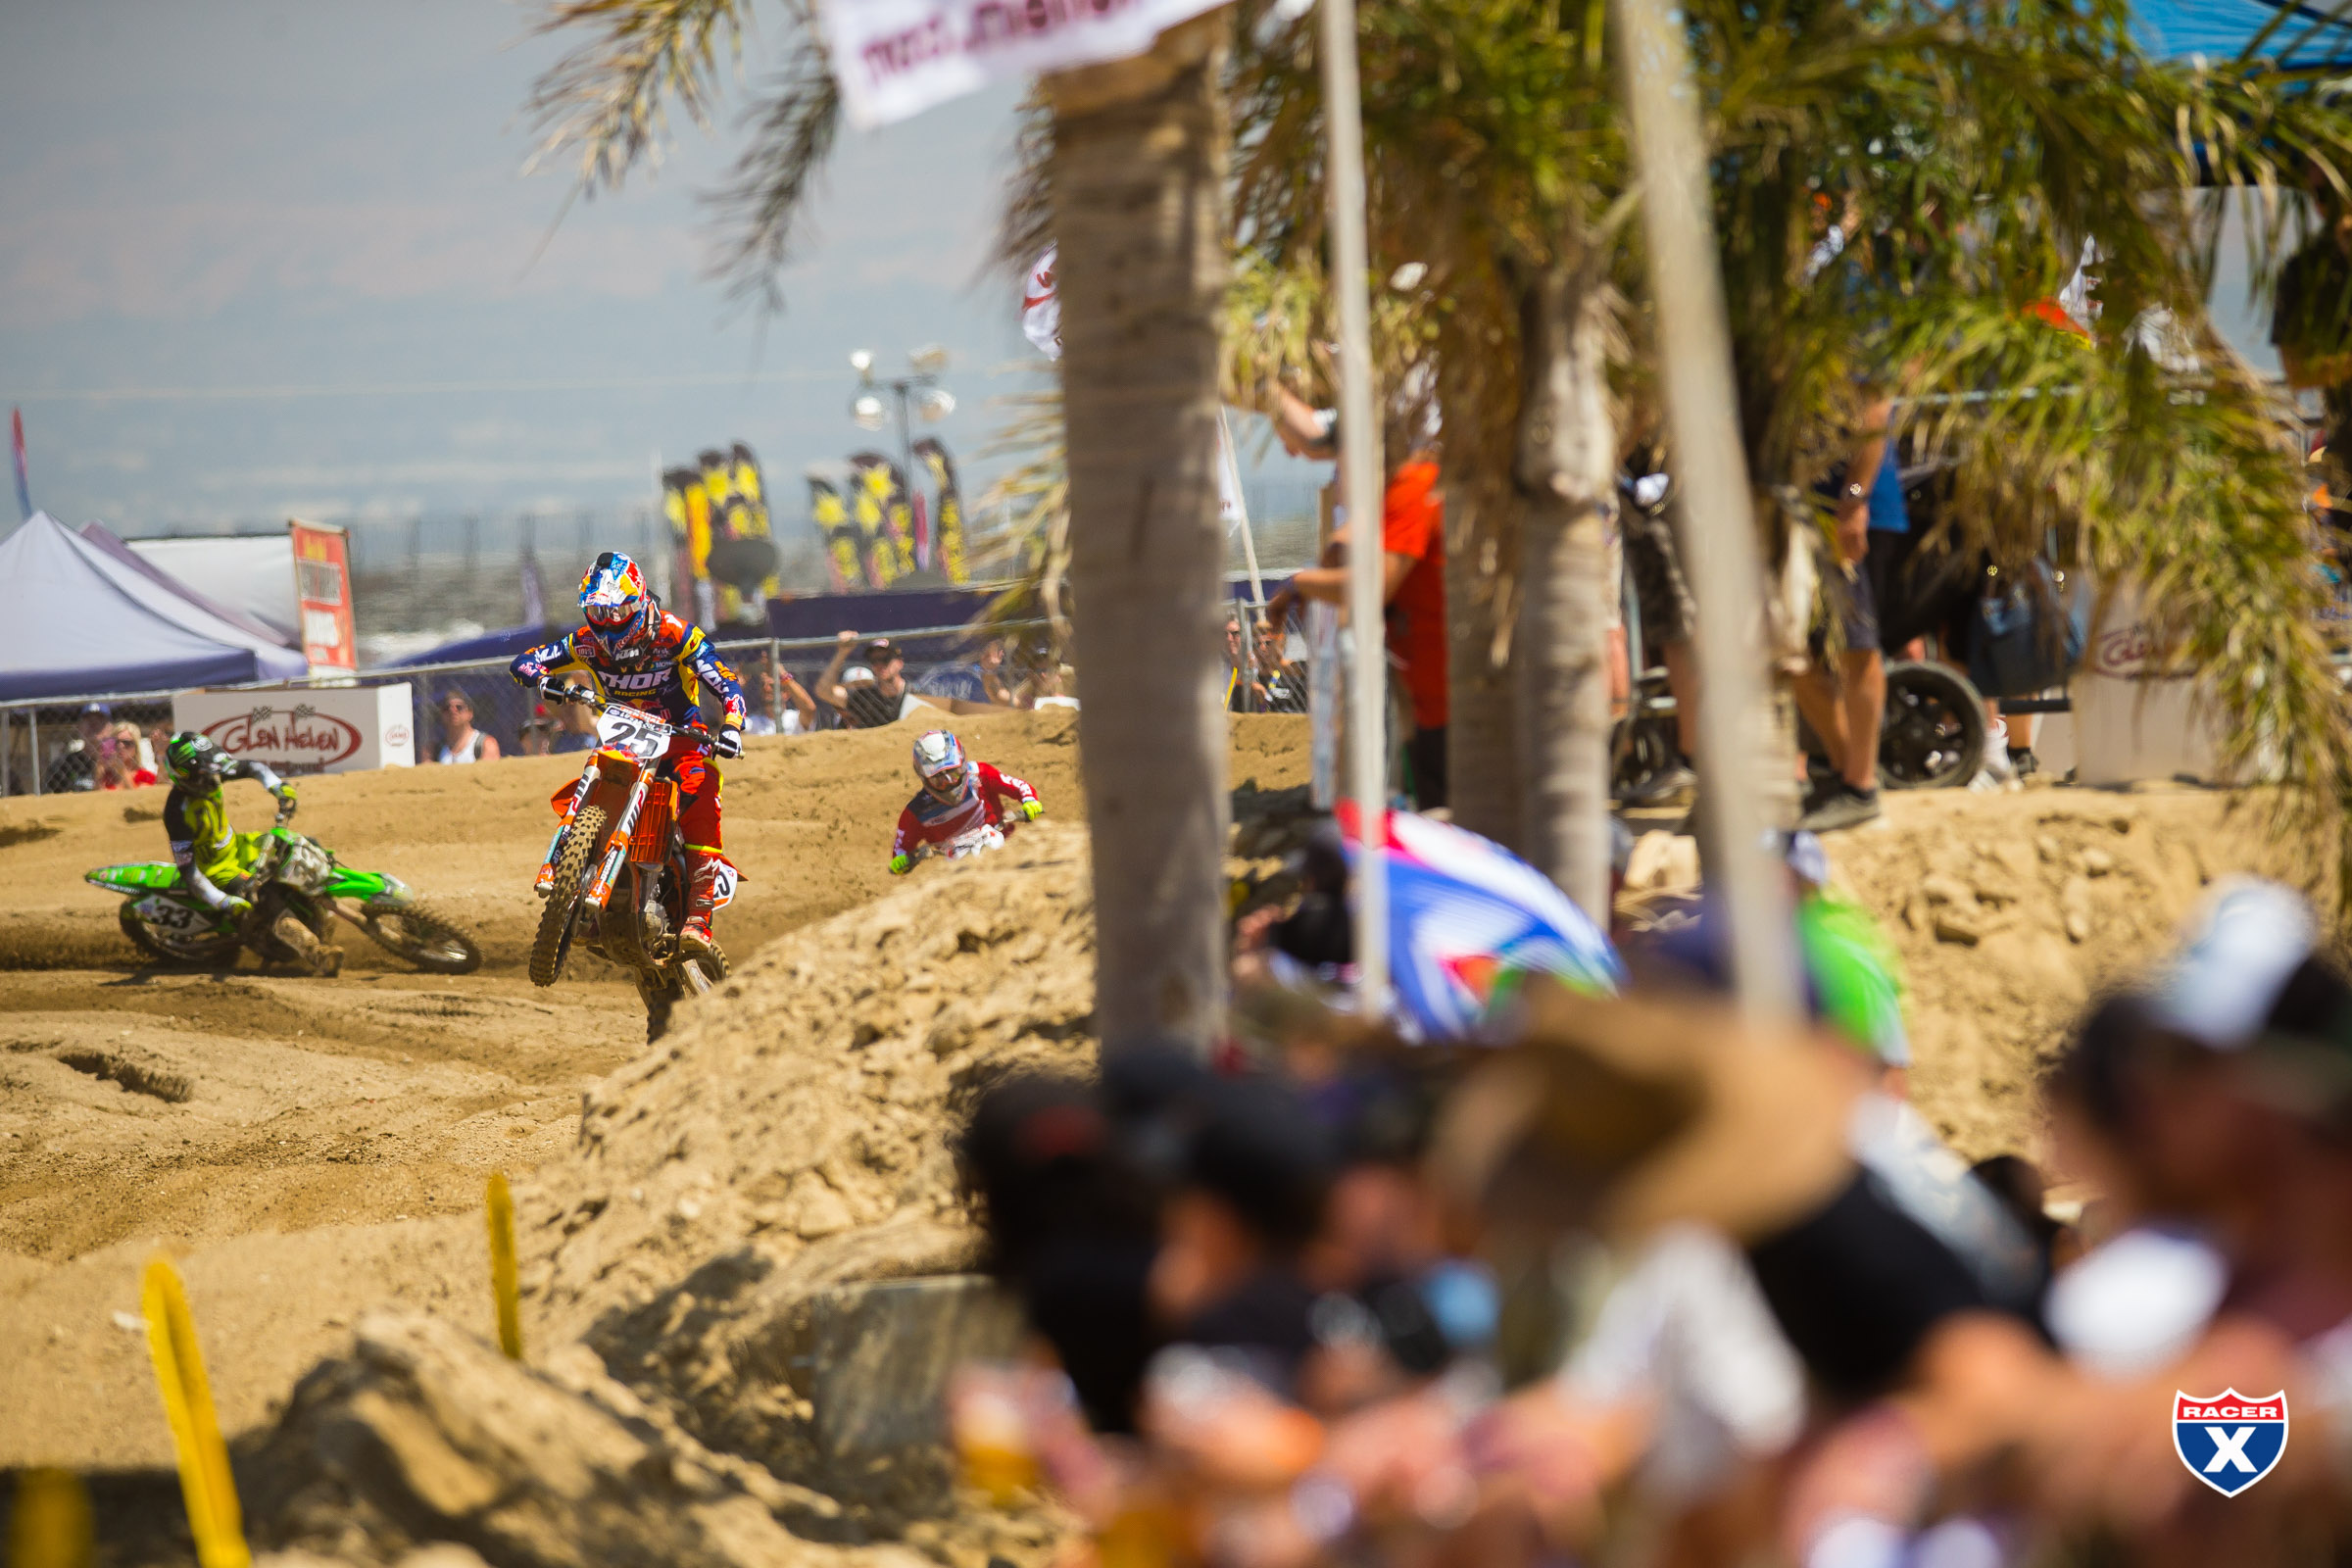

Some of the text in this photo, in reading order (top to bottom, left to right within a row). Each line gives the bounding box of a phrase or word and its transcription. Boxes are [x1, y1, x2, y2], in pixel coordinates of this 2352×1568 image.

[597, 667, 672, 690] THOR
[613, 689, 657, 698] RACING
[605, 721, 658, 757] 25
[154, 903, 192, 930] 33
